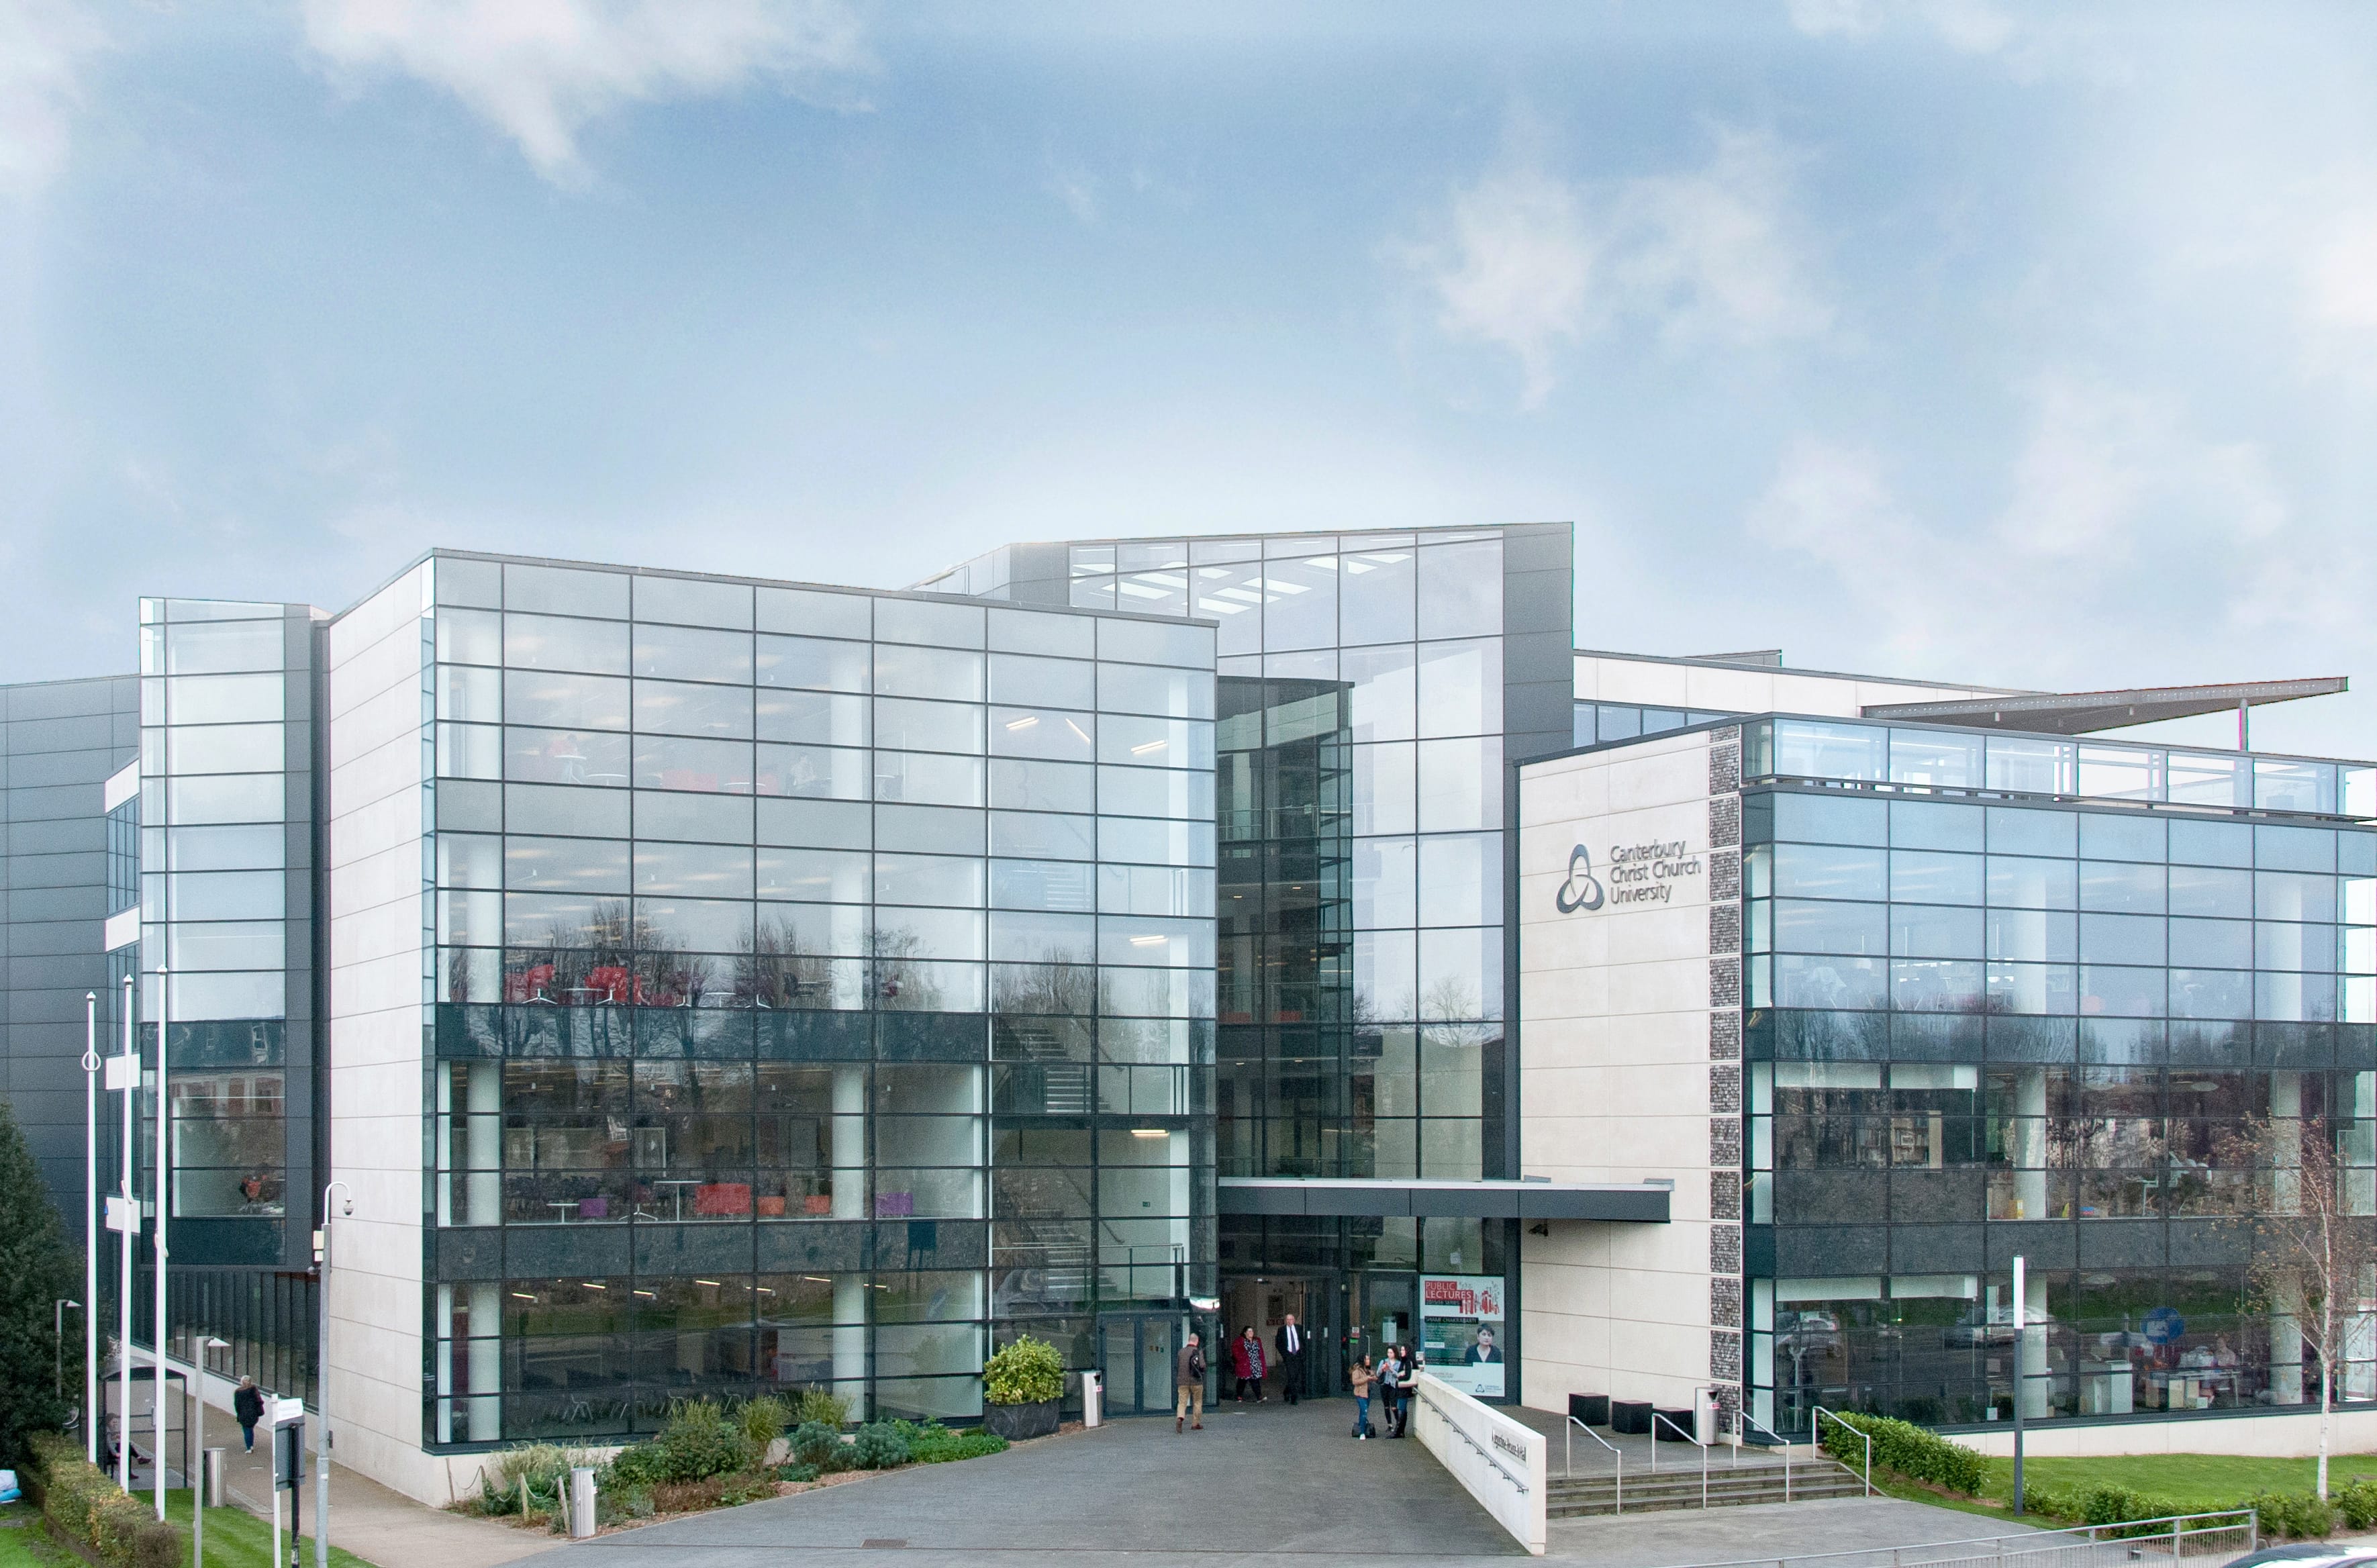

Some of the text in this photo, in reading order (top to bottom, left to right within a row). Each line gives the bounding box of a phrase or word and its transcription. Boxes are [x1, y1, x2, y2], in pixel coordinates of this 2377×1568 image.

[1610, 839, 1686, 863] Canterbury
[1610, 855, 1701, 883] Christ Church
[1610, 883, 1672, 904] University
[1426, 1281, 1456, 1291] PUBLIC
[1426, 1290, 1471, 1300] LECTURES
